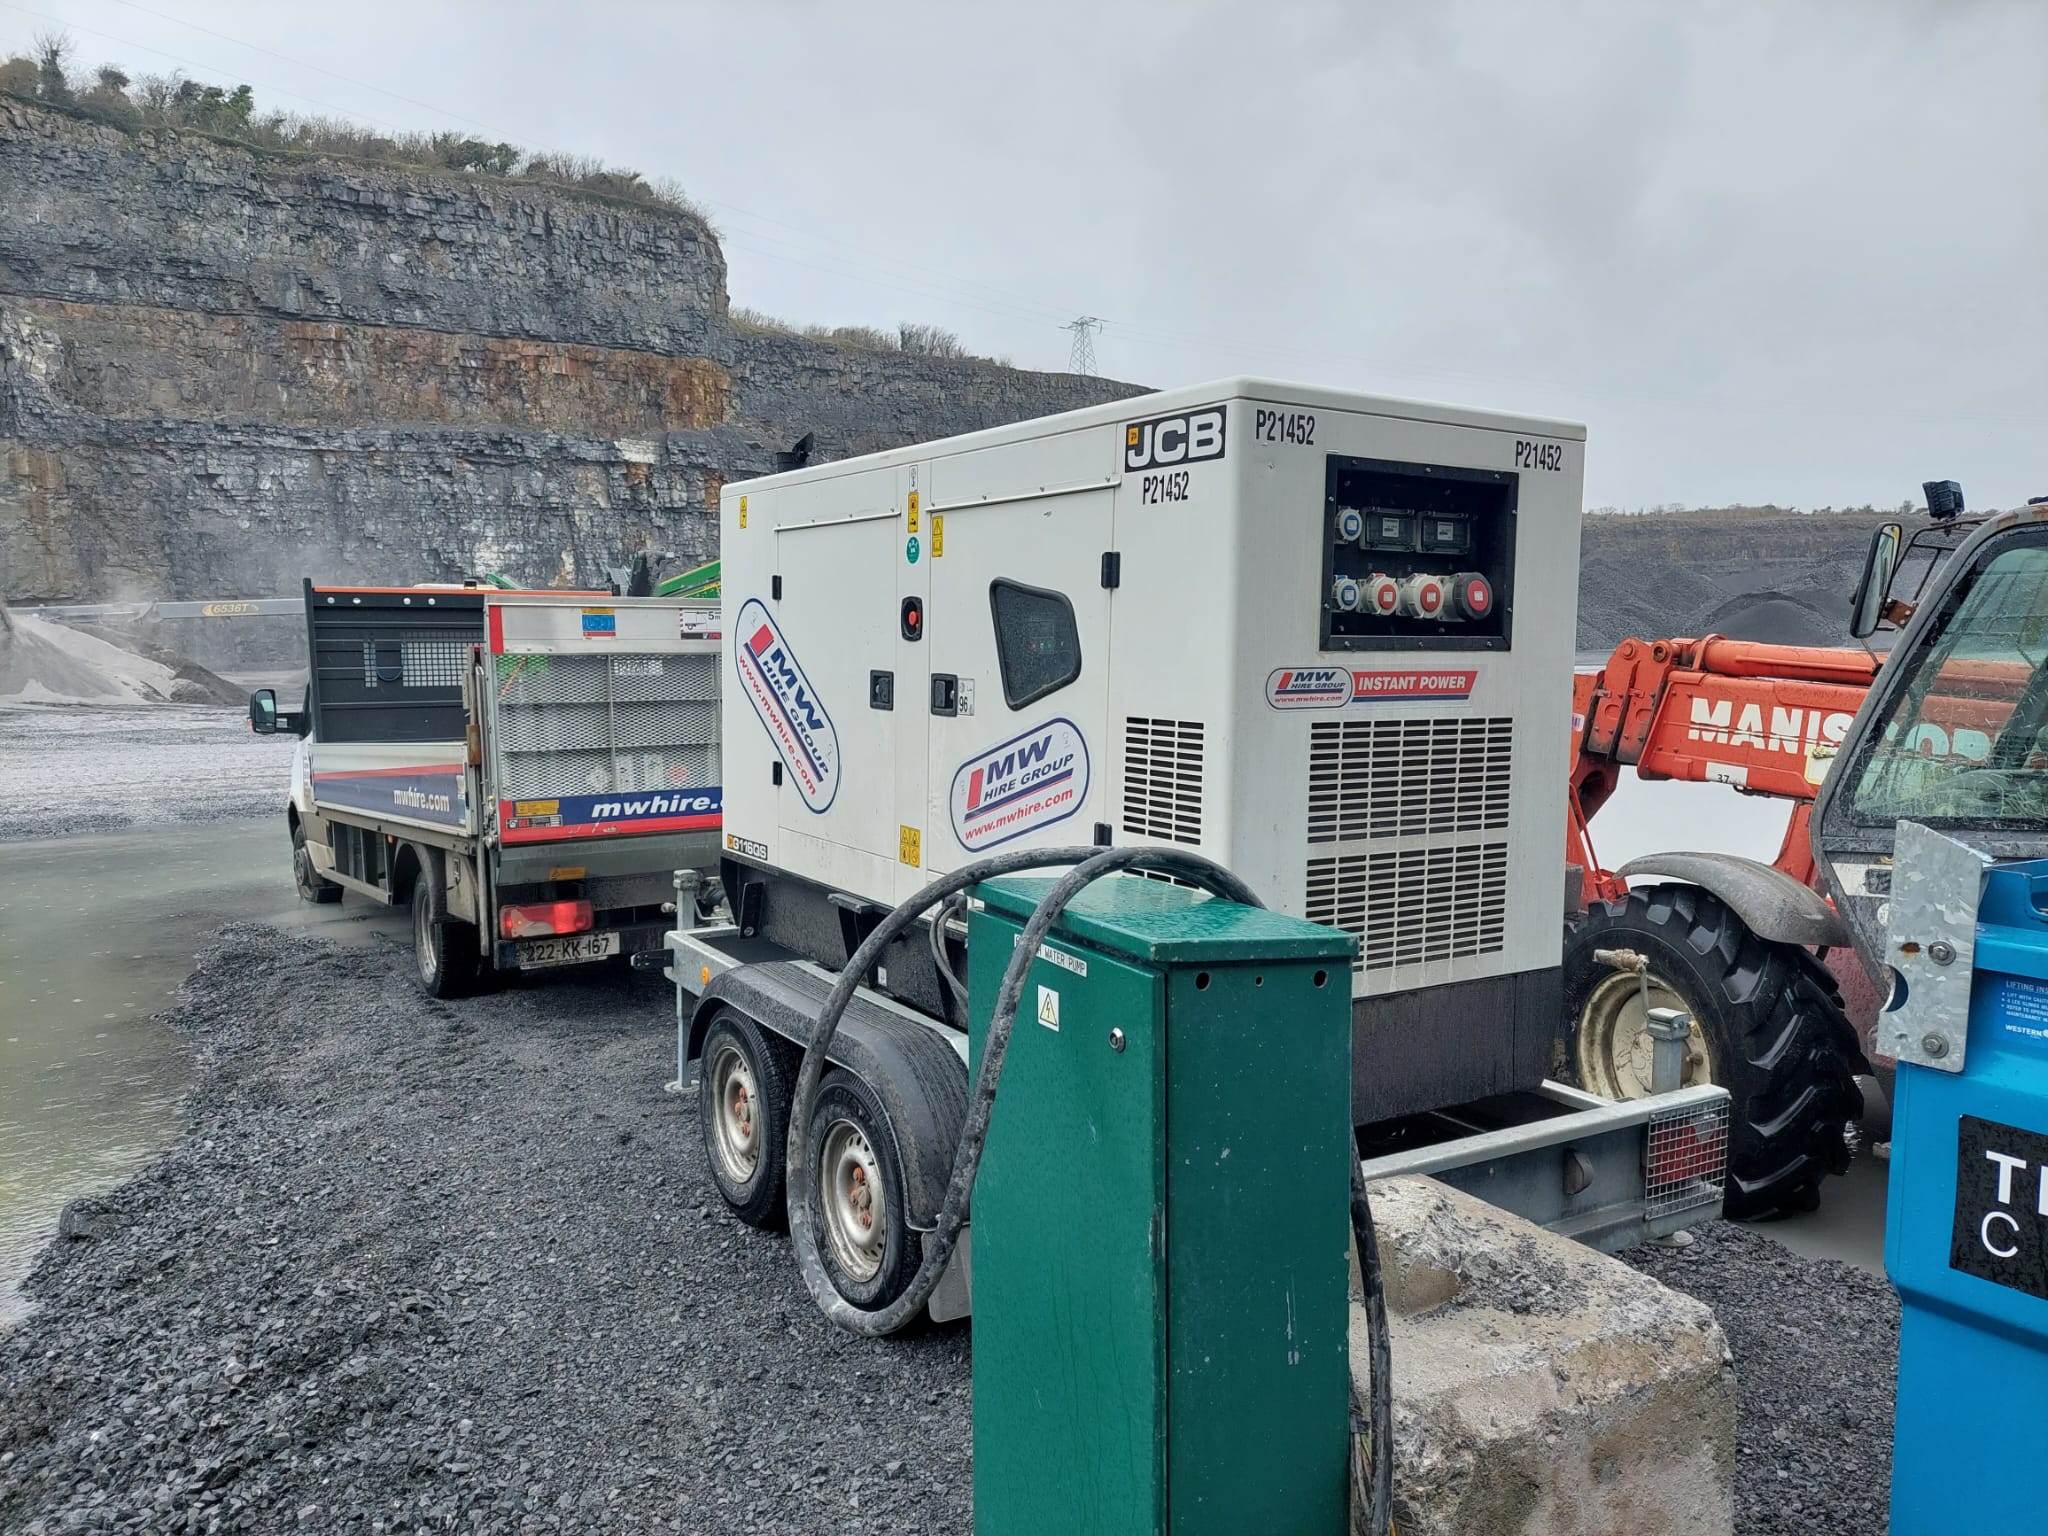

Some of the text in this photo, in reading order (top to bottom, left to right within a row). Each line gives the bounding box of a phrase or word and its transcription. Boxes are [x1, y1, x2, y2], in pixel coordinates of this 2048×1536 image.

[1126, 411, 1223, 468] JCB
[1256, 408, 1315, 446] P21452
[1515, 440, 1562, 472] P21452
[1142, 471, 1189, 505] P21452
[213, 603, 250, 614] 6536T
[770, 647, 825, 730] MW
[1293, 671, 1337, 682] MW
[1358, 675, 1467, 691] INSTANT POWER
[739, 655, 817, 796] www.mwhire.com
[762, 660, 830, 774] HIRE GROUP
[986, 734, 1053, 785] MW
[984, 753, 1074, 802] HIRE GROUP
[393, 785, 450, 813] mwhire.com
[591, 794, 722, 819] mwhire.
[965, 788, 1073, 841] www.mwhire.com
[526, 937, 611, 961] 222-KK-167
[1044, 946, 1085, 974] WATER PUMP
[2005, 1023, 2042, 1036] WESTERN
[1985, 1149, 2048, 1217] T
